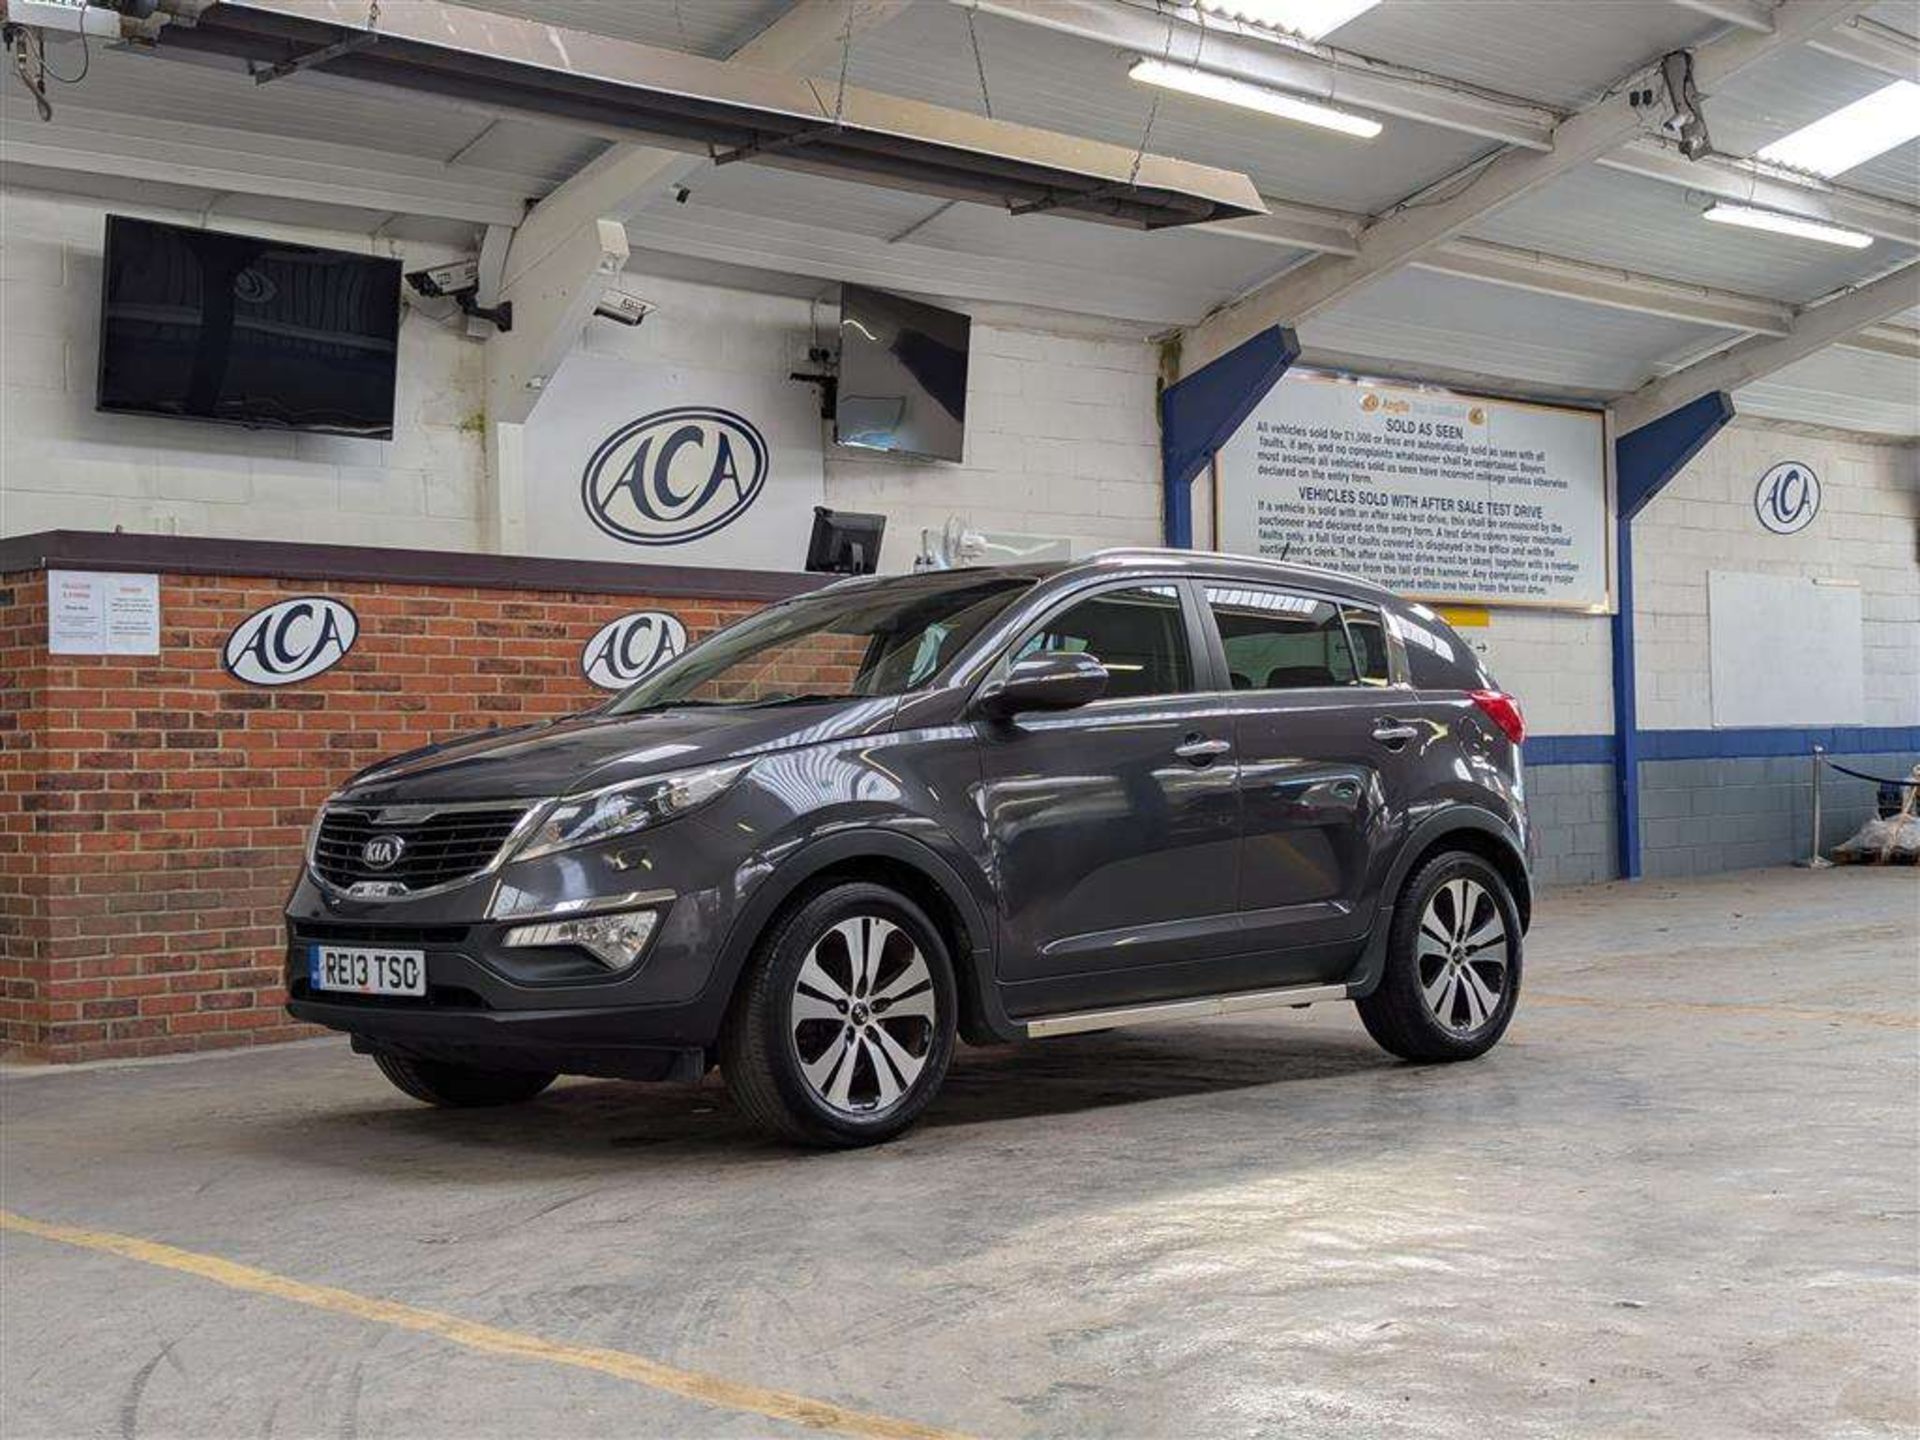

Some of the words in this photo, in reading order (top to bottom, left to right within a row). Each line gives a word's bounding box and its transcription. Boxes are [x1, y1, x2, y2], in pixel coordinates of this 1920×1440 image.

[1386, 418, 1415, 434] SOLD
[1419, 424, 1433, 436] AS
[1436, 425, 1463, 439] SEEN
[601, 426, 744, 521] ACA
[1299, 487, 1355, 504] VEHICLES
[1359, 491, 1388, 506] SOLD
[1391, 494, 1418, 508] WITH
[1421, 496, 1453, 511] AFTER
[1457, 501, 1483, 514] SALE
[1486, 502, 1512, 516] TEST
[1515, 505, 1542, 519] DRIVE
[1760, 470, 1811, 523] ACA
[231, 604, 345, 674] ACA
[587, 617, 676, 679] ACA
[367, 843, 391, 861] KIA
[326, 952, 368, 985] RE13
